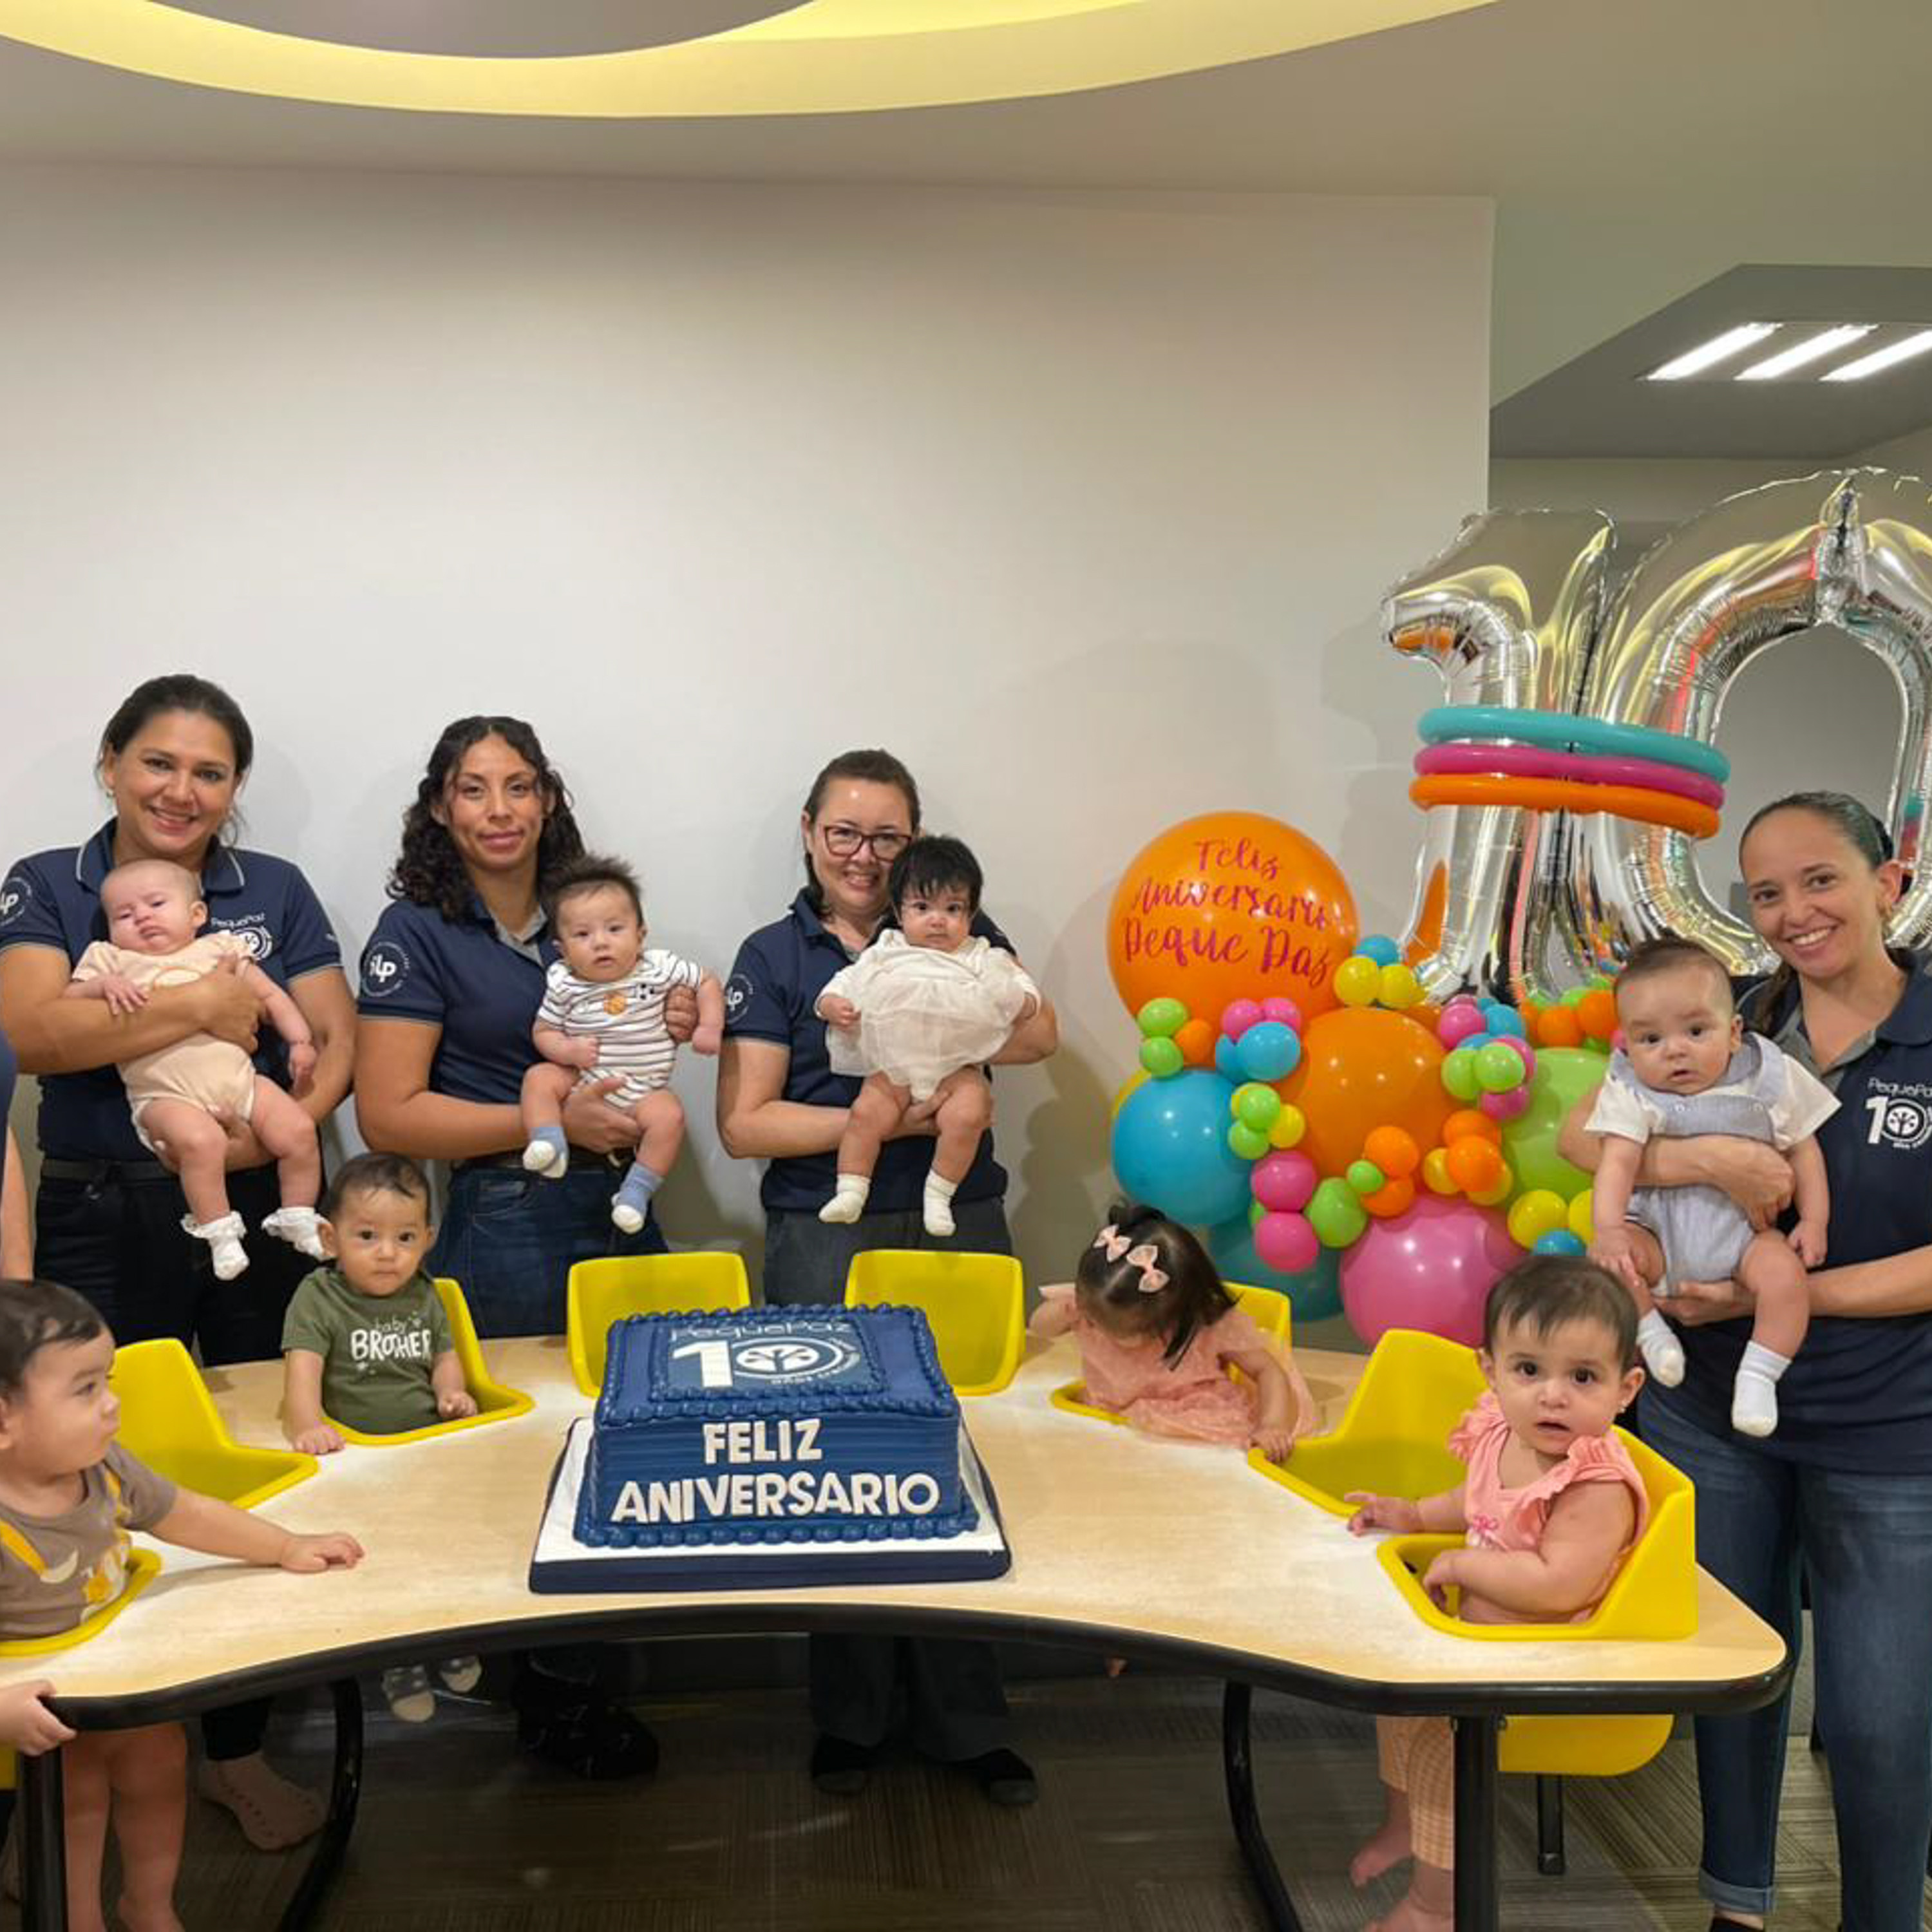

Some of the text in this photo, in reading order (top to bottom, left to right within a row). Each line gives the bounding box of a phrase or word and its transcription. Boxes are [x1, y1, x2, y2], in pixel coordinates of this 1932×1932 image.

[1124, 917, 1329, 989] Peque Paz
[1868, 1077, 1932, 1098] PequePa
[375, 1314, 408, 1334] baby
[351, 1329, 431, 1362] BROTHER
[703, 1418, 822, 1464] FELIZ
[610, 1470, 940, 1524] ANIVERSARIO
